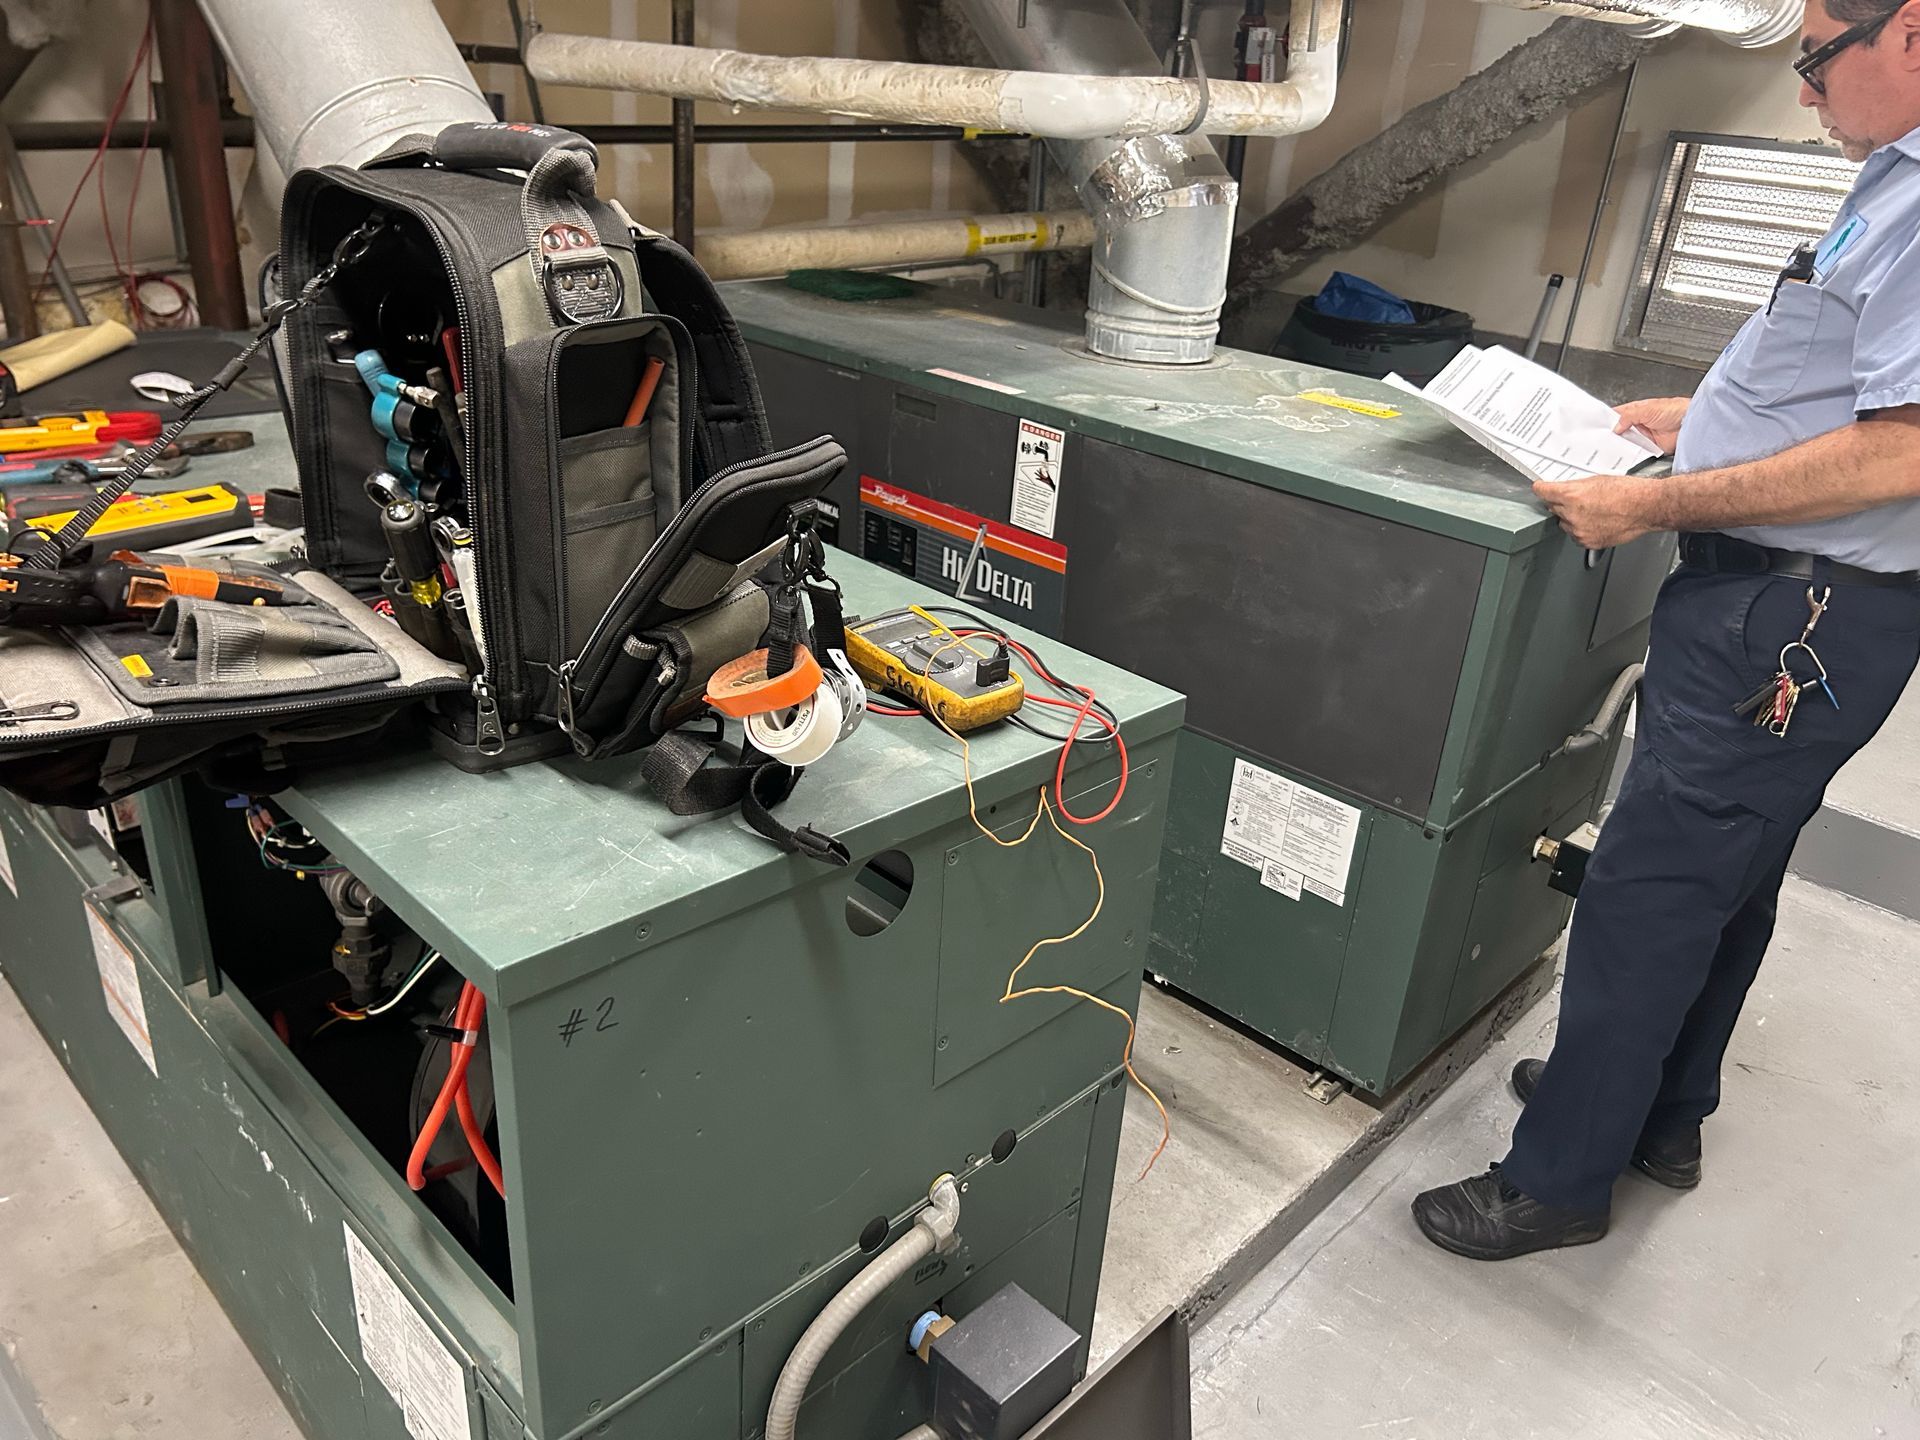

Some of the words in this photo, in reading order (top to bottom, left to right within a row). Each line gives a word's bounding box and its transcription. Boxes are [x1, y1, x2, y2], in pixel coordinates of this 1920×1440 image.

[1029, 425, 1061, 441] DANGER
[976, 559, 1032, 610] DELTA
[558, 996, 619, 1048] #2
